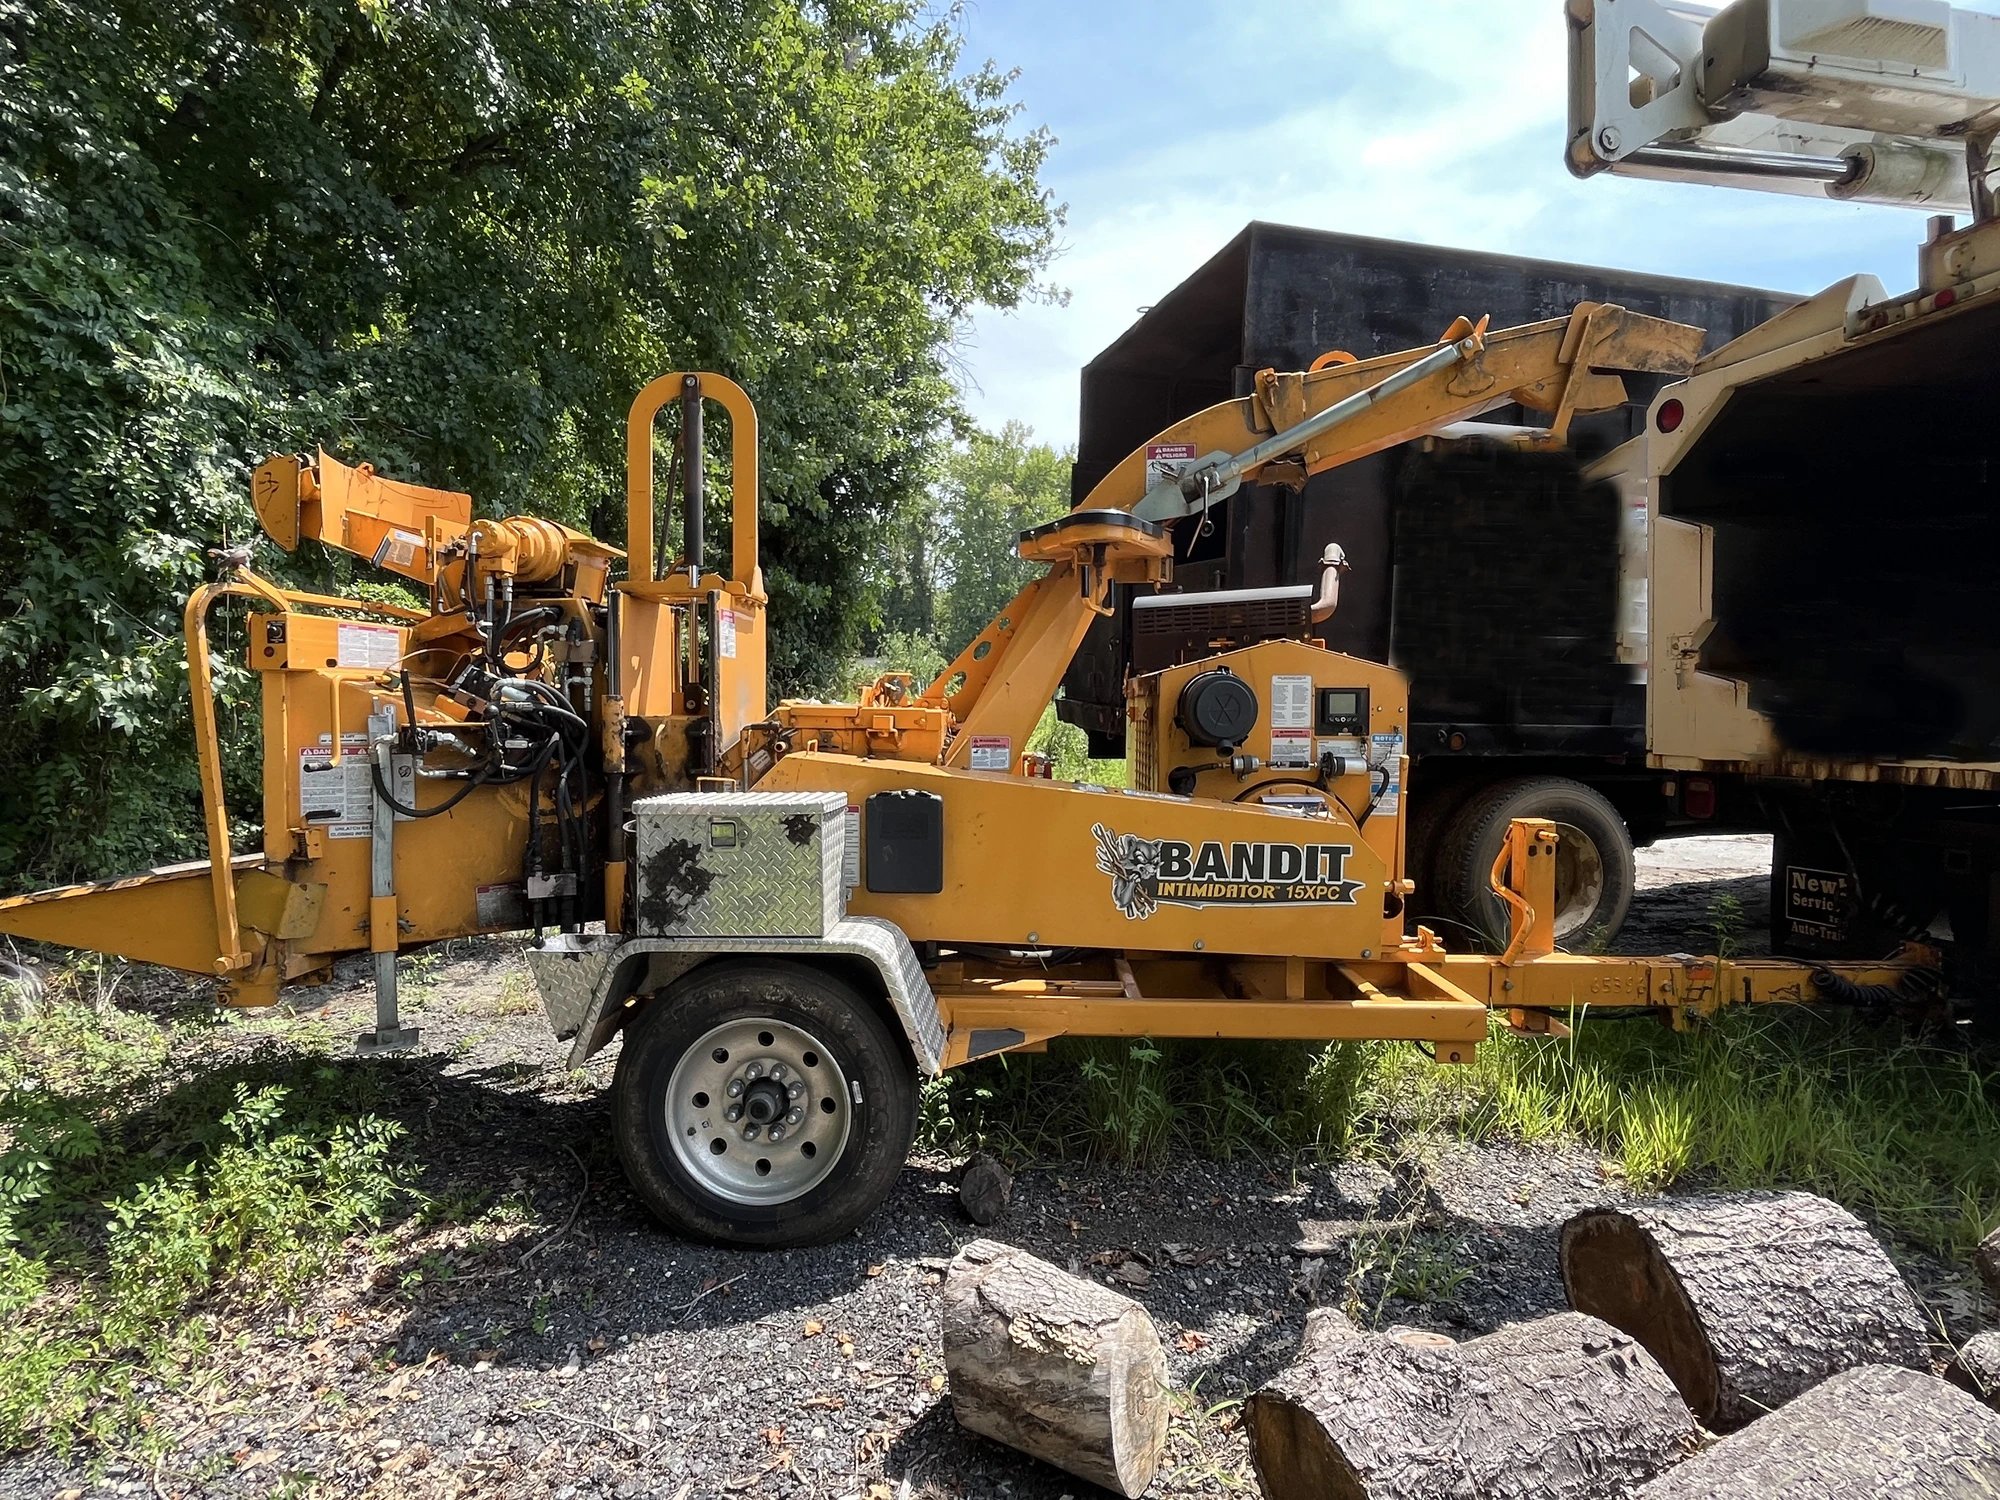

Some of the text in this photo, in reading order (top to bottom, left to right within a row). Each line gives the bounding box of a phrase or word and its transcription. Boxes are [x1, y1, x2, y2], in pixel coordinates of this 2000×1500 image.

[1157, 842, 1352, 882] BANDIT
[1286, 885, 1341, 901] 15XPC
[1792, 893, 1841, 912] Servic
